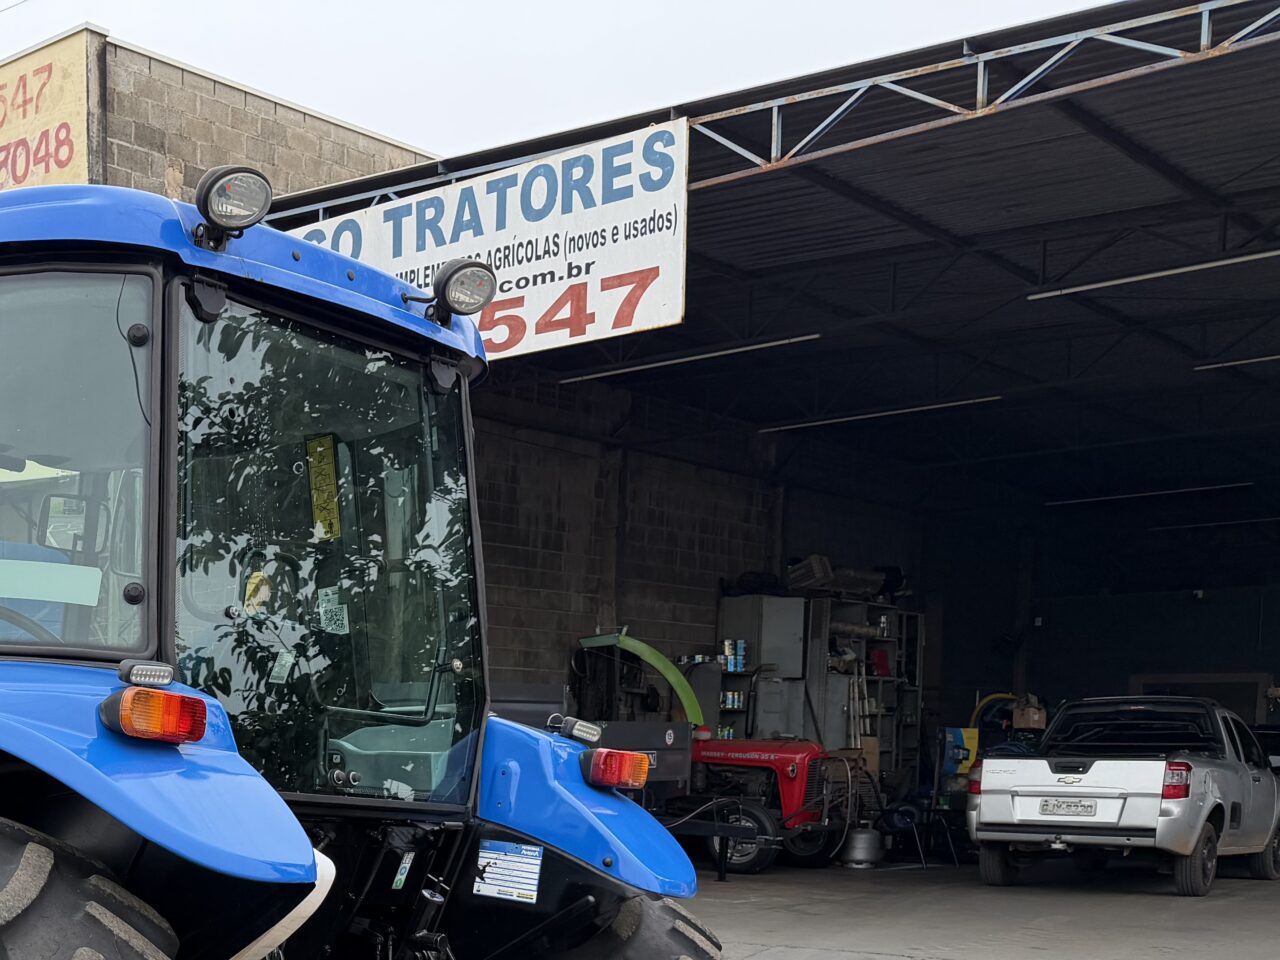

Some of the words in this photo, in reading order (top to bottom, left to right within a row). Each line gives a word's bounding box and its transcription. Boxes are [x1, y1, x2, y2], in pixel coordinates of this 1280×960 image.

[384, 130, 676, 259] TRATORES
[487, 233, 560, 271] AGRÍCOLAS
[564, 228, 607, 262] (novos
[611, 224, 619, 244] e
[623, 203, 678, 241] usados)
